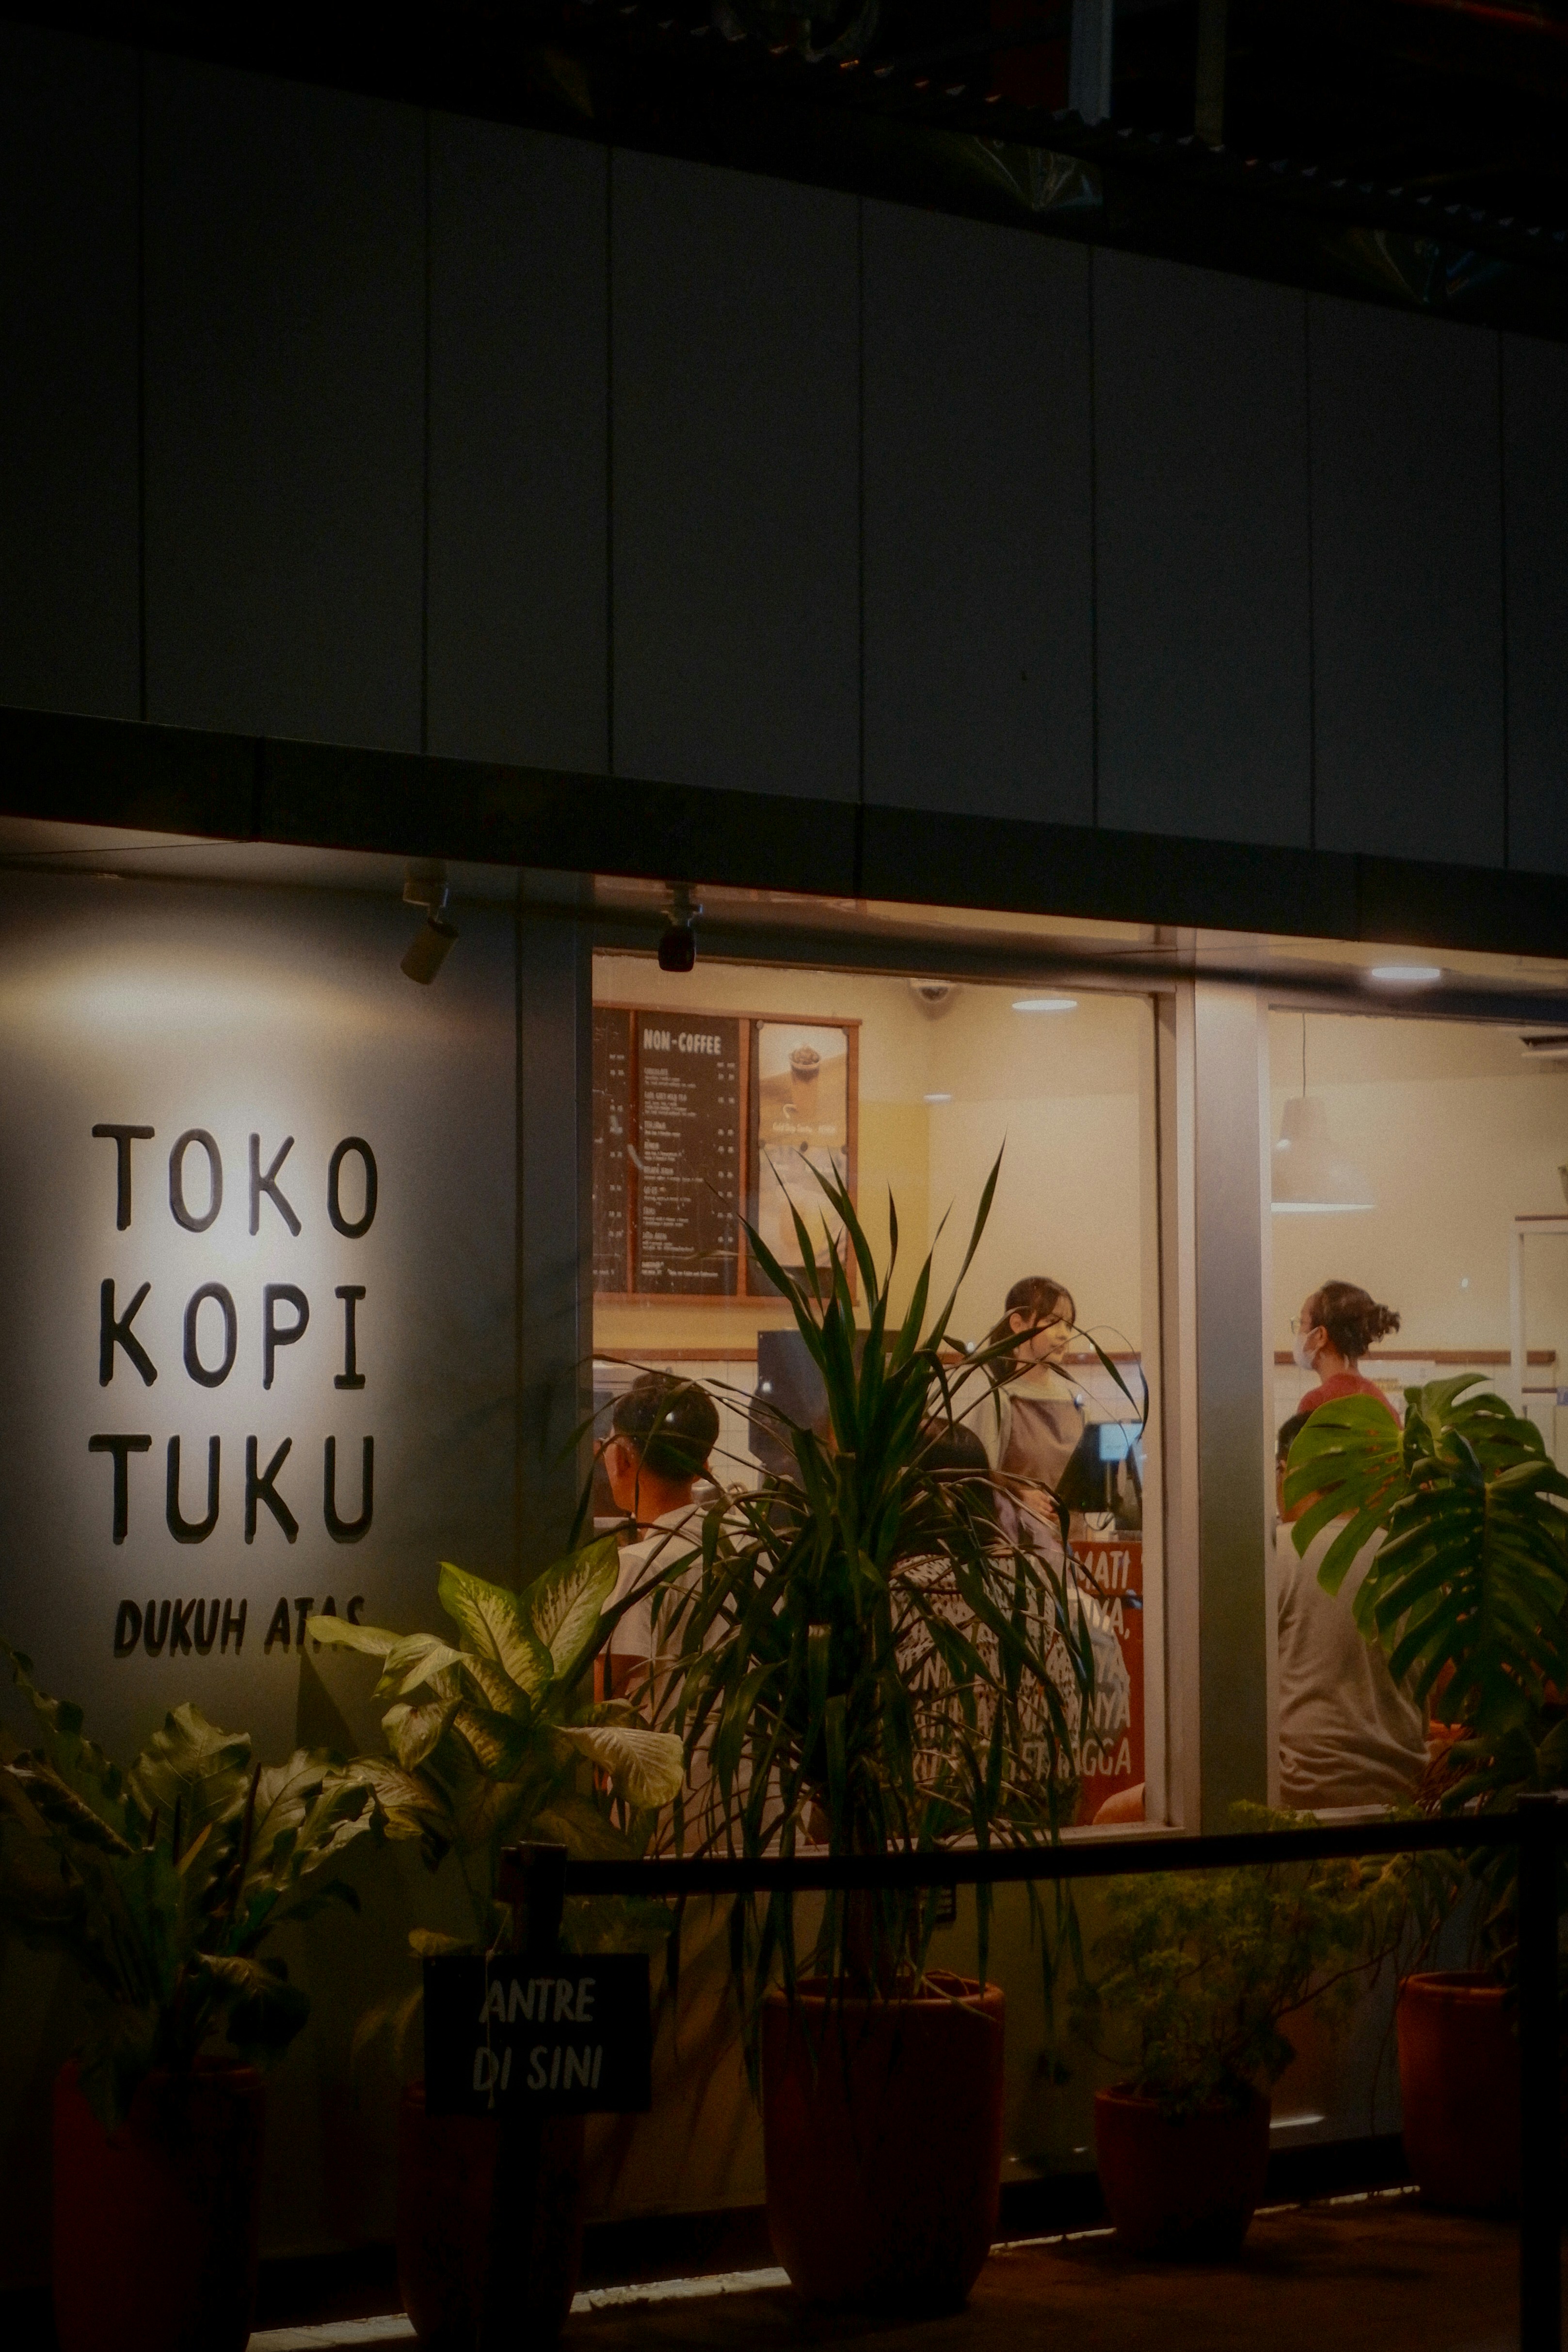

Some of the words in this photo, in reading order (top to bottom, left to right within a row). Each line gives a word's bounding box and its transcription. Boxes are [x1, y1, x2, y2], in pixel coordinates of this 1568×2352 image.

[643, 1028, 721, 1055] NON-COFFEE
[92, 1124, 378, 1239] TOKO
[99, 1278, 367, 1390] KOPI
[88, 1434, 375, 1544] TUKU
[114, 1597, 248, 1657] DUKUH
[478, 1977, 596, 2023] ANTRE
[472, 2046, 512, 2091] DI
[527, 2044, 604, 2091] SINI
